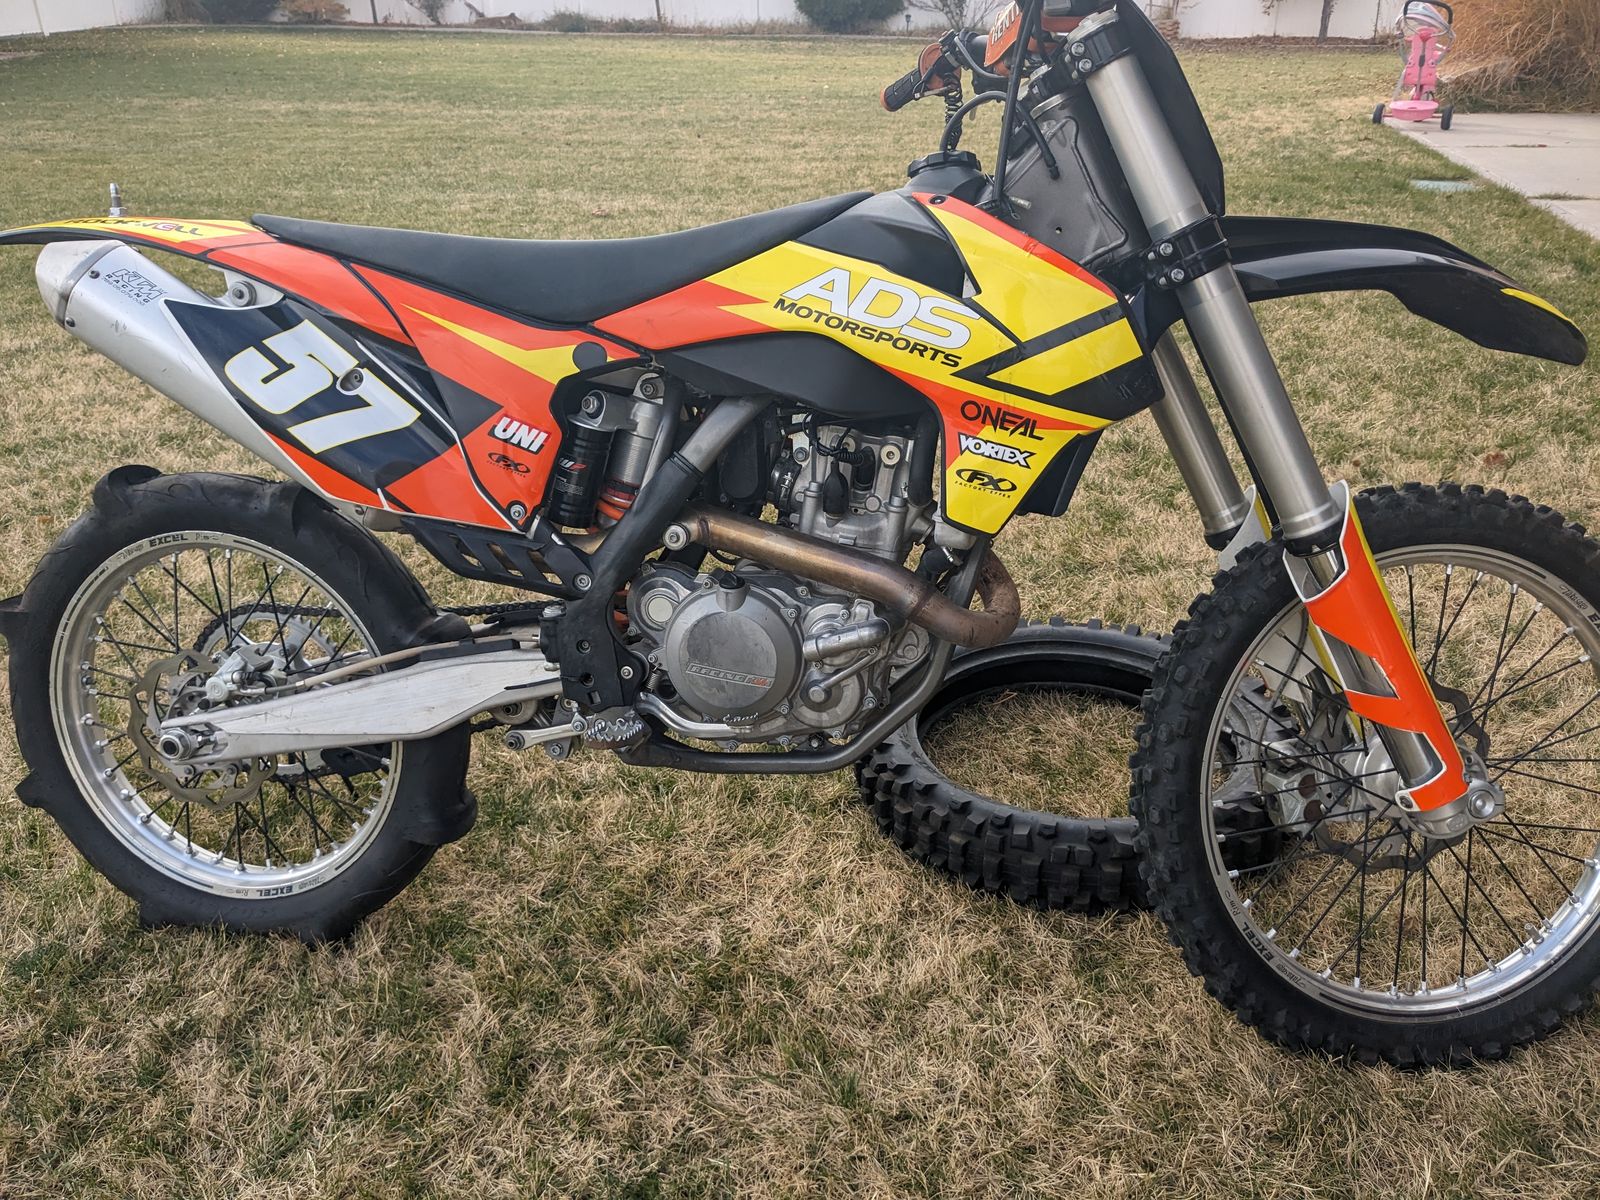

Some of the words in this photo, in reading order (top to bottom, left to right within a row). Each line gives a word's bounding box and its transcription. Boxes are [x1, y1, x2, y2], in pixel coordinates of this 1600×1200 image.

[105, 273, 151, 304] RACING
[112, 268, 164, 301] KTM
[780, 267, 982, 349] ADS
[773, 298, 963, 368] MOTORSPORTS
[224, 319, 422, 455] 57
[493, 416, 549, 452] UNI
[959, 432, 1036, 469] VORTEX
[954, 480, 987, 492] FACTORY
[149, 534, 189, 548] EXCEL
[690, 665, 746, 682] RACING
[256, 885, 293, 897] EXCEL
[1229, 900, 1241, 917] Rim
[1241, 922, 1275, 962] EXCEL
